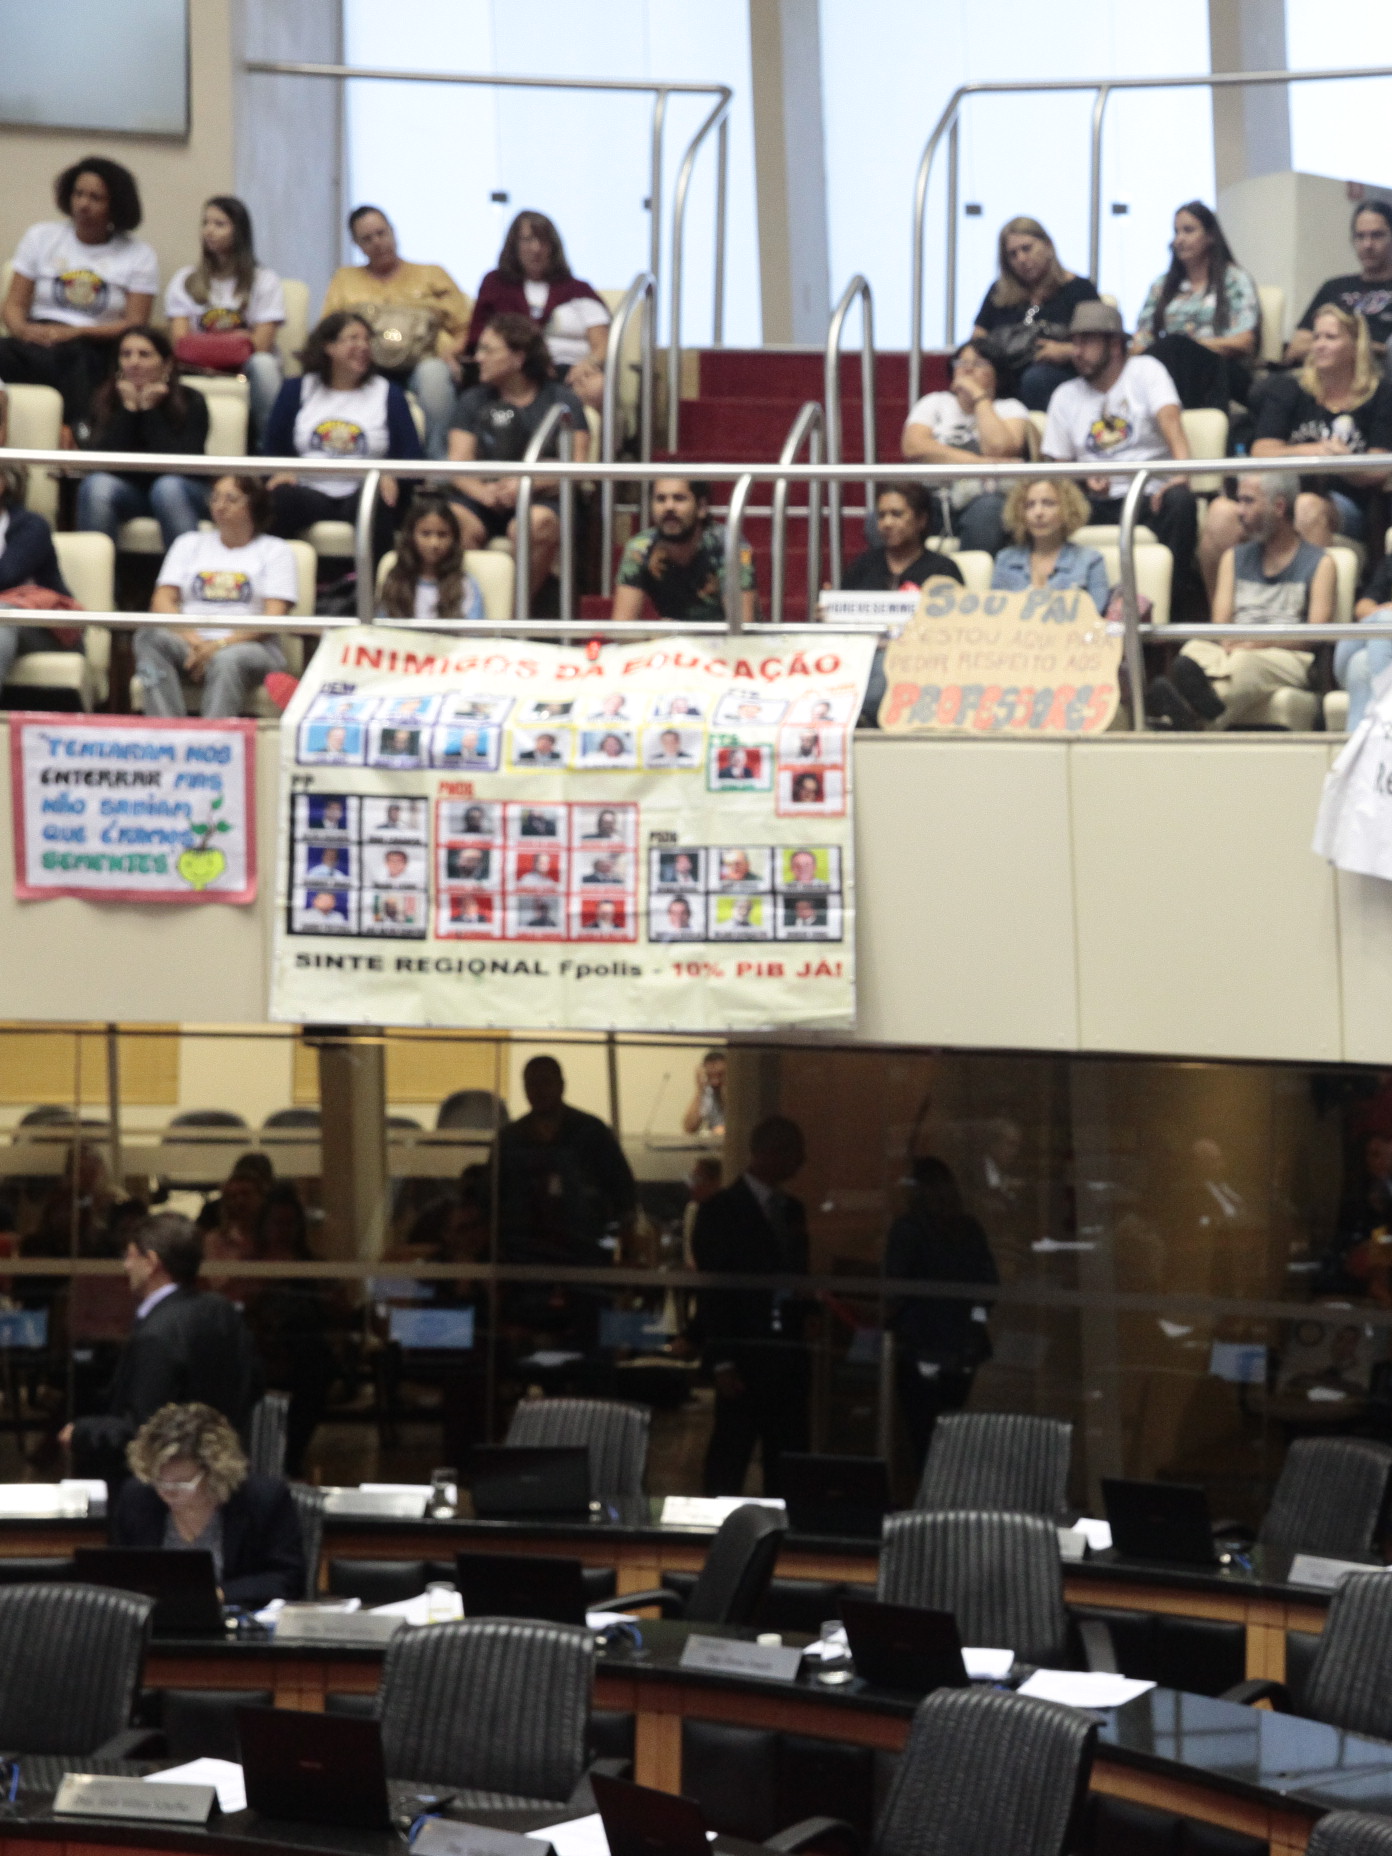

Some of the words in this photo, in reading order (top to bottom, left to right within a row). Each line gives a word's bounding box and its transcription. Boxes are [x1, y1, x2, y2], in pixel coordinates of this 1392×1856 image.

[1020, 586, 1080, 623] PAI
[918, 626, 1000, 647] ESTOU
[340, 645, 539, 680] INIMIGOS
[555, 662, 604, 680] DA
[621, 650, 842, 682] EDUCAÇÃO
[954, 651, 1058, 672] RESPEITO
[885, 683, 1115, 730] PROFESSORES
[185, 745, 232, 764] NOS
[40, 768, 161, 787] ENTERRAR
[42, 824, 86, 843] QUE
[294, 953, 384, 973] SINTE
[396, 956, 549, 977] REGIONAL
[560, 959, 642, 979] Fpolis
[672, 961, 725, 978] 10%
[737, 961, 784, 978] PIB
